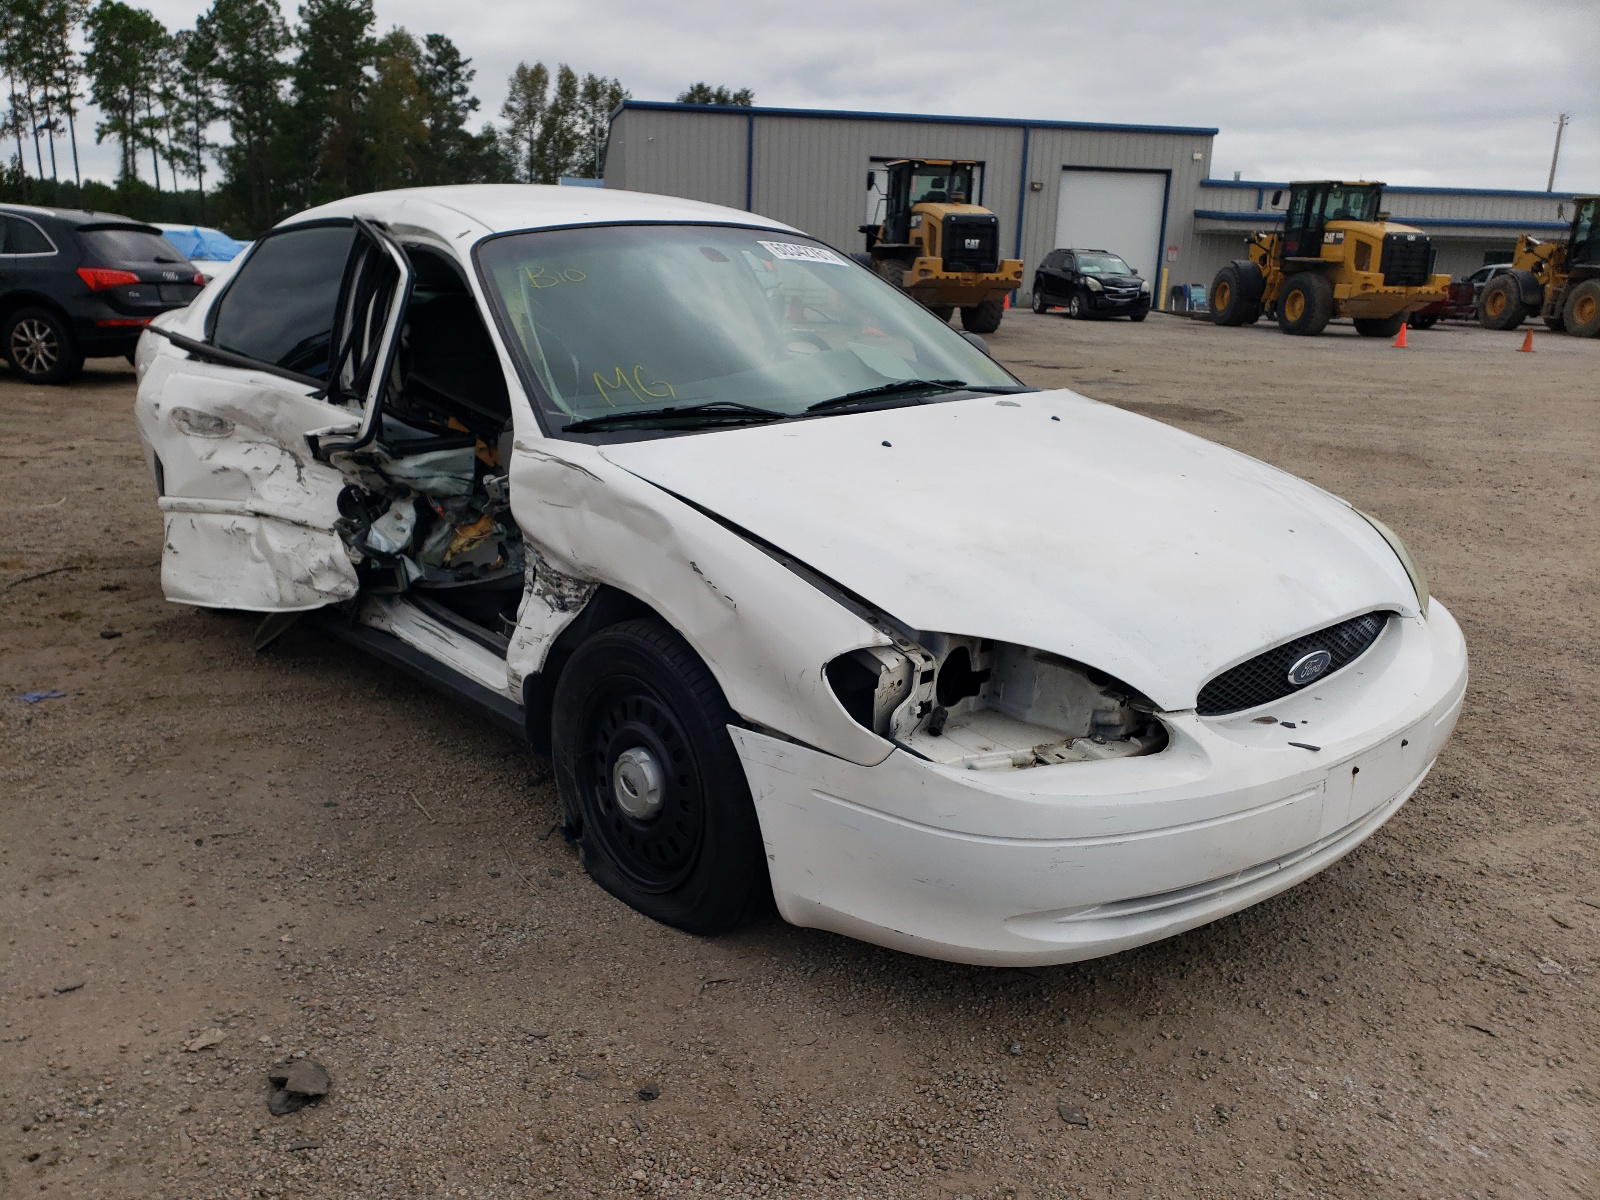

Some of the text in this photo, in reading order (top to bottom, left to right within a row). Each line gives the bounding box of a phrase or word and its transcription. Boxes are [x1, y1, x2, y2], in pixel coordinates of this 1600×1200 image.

[964, 238, 981, 249] CAT
[592, 364, 676, 408] MG
[1300, 657, 1324, 678] Ford
